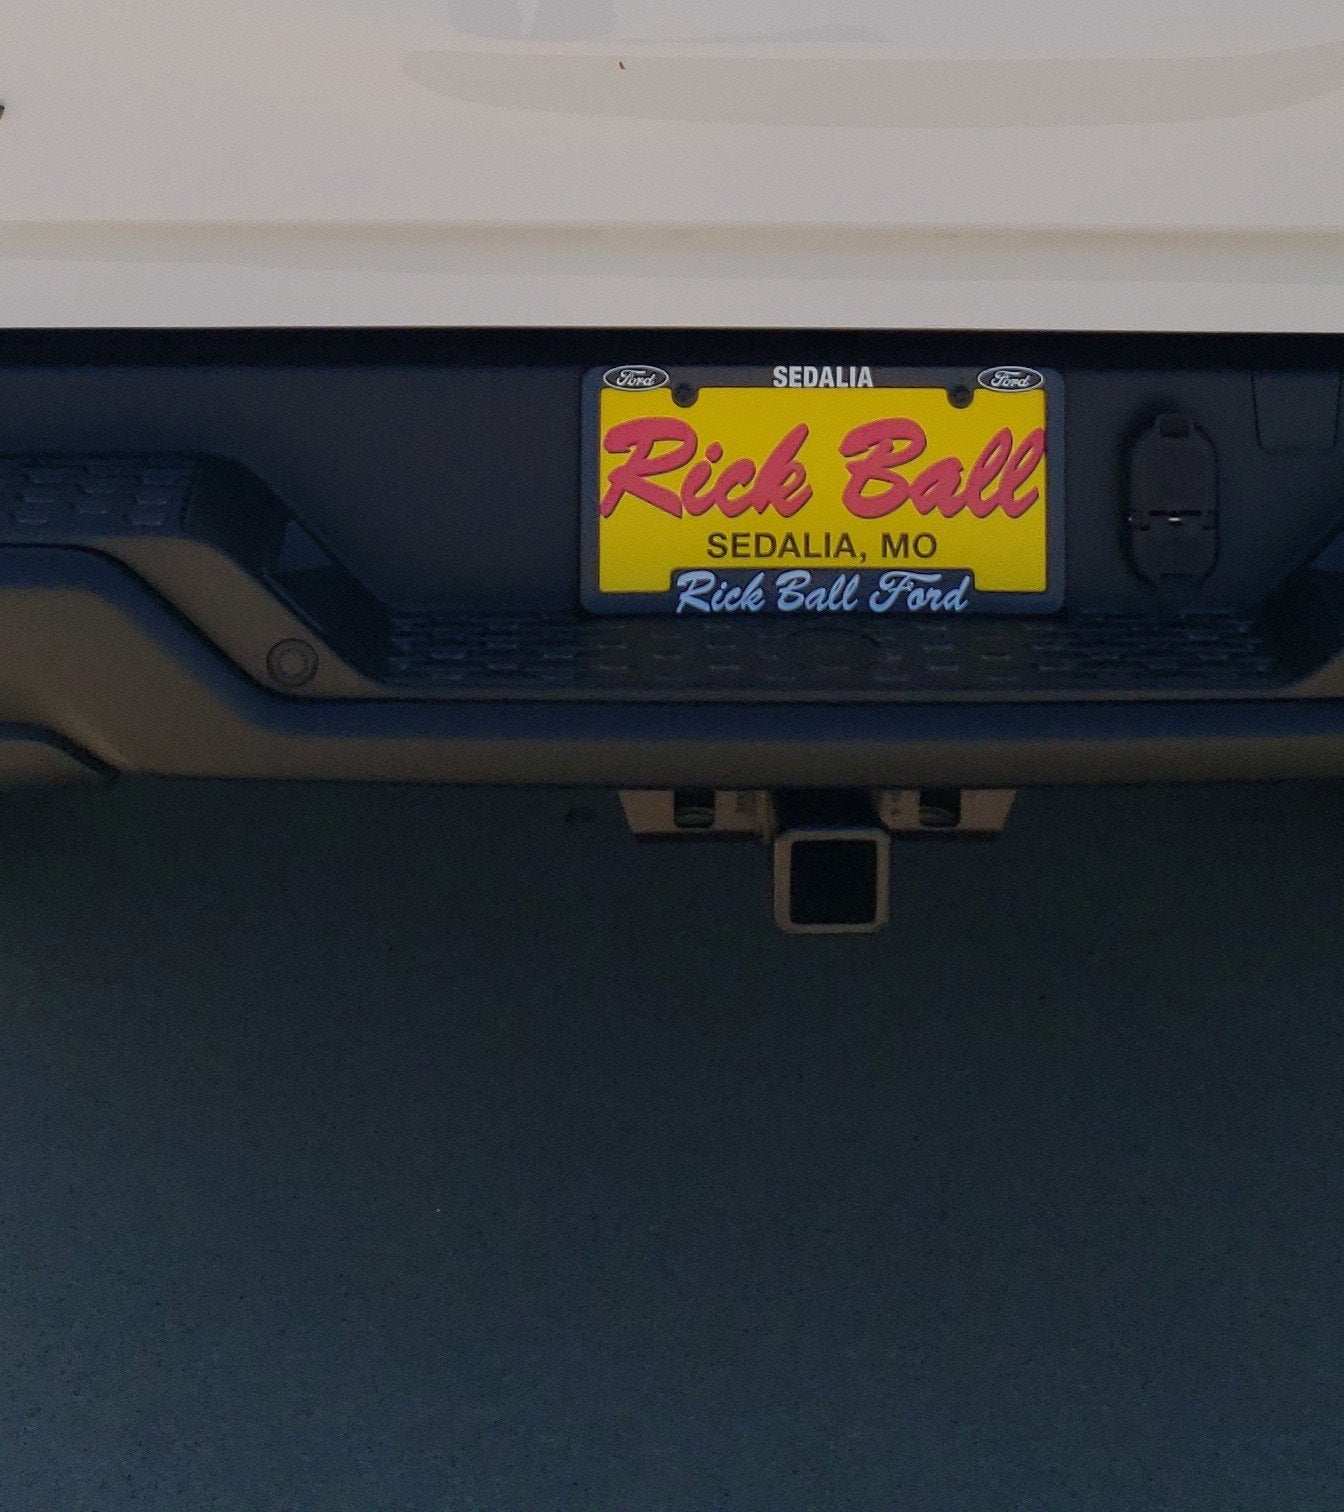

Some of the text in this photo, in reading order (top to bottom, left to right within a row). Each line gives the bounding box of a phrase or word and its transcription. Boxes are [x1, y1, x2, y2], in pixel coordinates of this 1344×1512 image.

[616, 369, 655, 386] Ford
[773, 366, 873, 388] SEDALIA
[990, 370, 1031, 387] Ford
[600, 417, 1046, 519] Rick Ball
[707, 532, 937, 563] SEDALIA, MO
[677, 571, 968, 614] Rick Ball Ford
